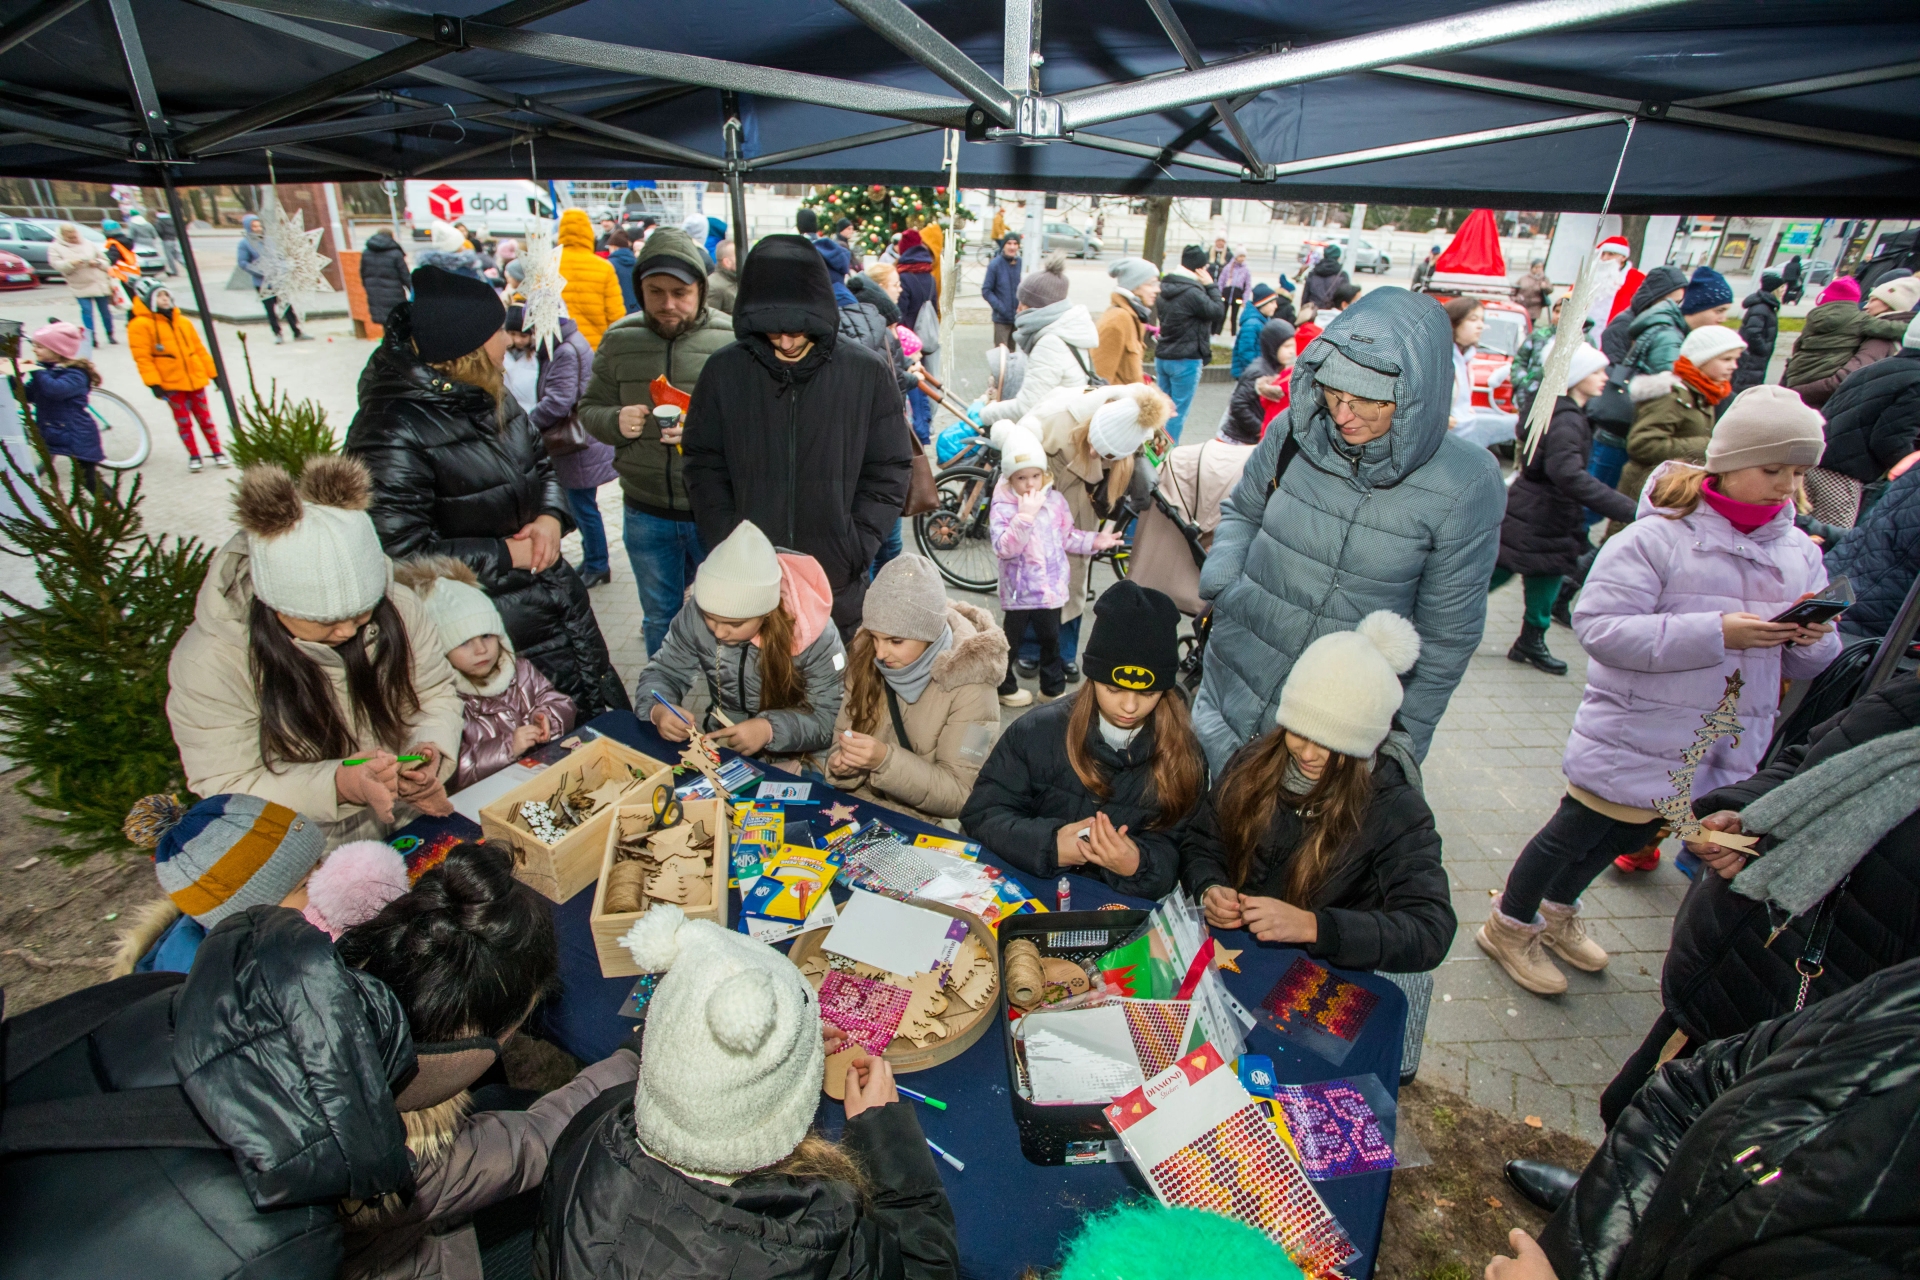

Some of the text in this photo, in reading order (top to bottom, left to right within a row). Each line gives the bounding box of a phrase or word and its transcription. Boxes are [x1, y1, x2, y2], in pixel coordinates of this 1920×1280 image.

[470, 192, 508, 214] dpd
[735, 854, 759, 868] ASTR
[1146, 1070, 1182, 1098] DIAMOND
[1250, 1070, 1270, 1085] ASTRA
